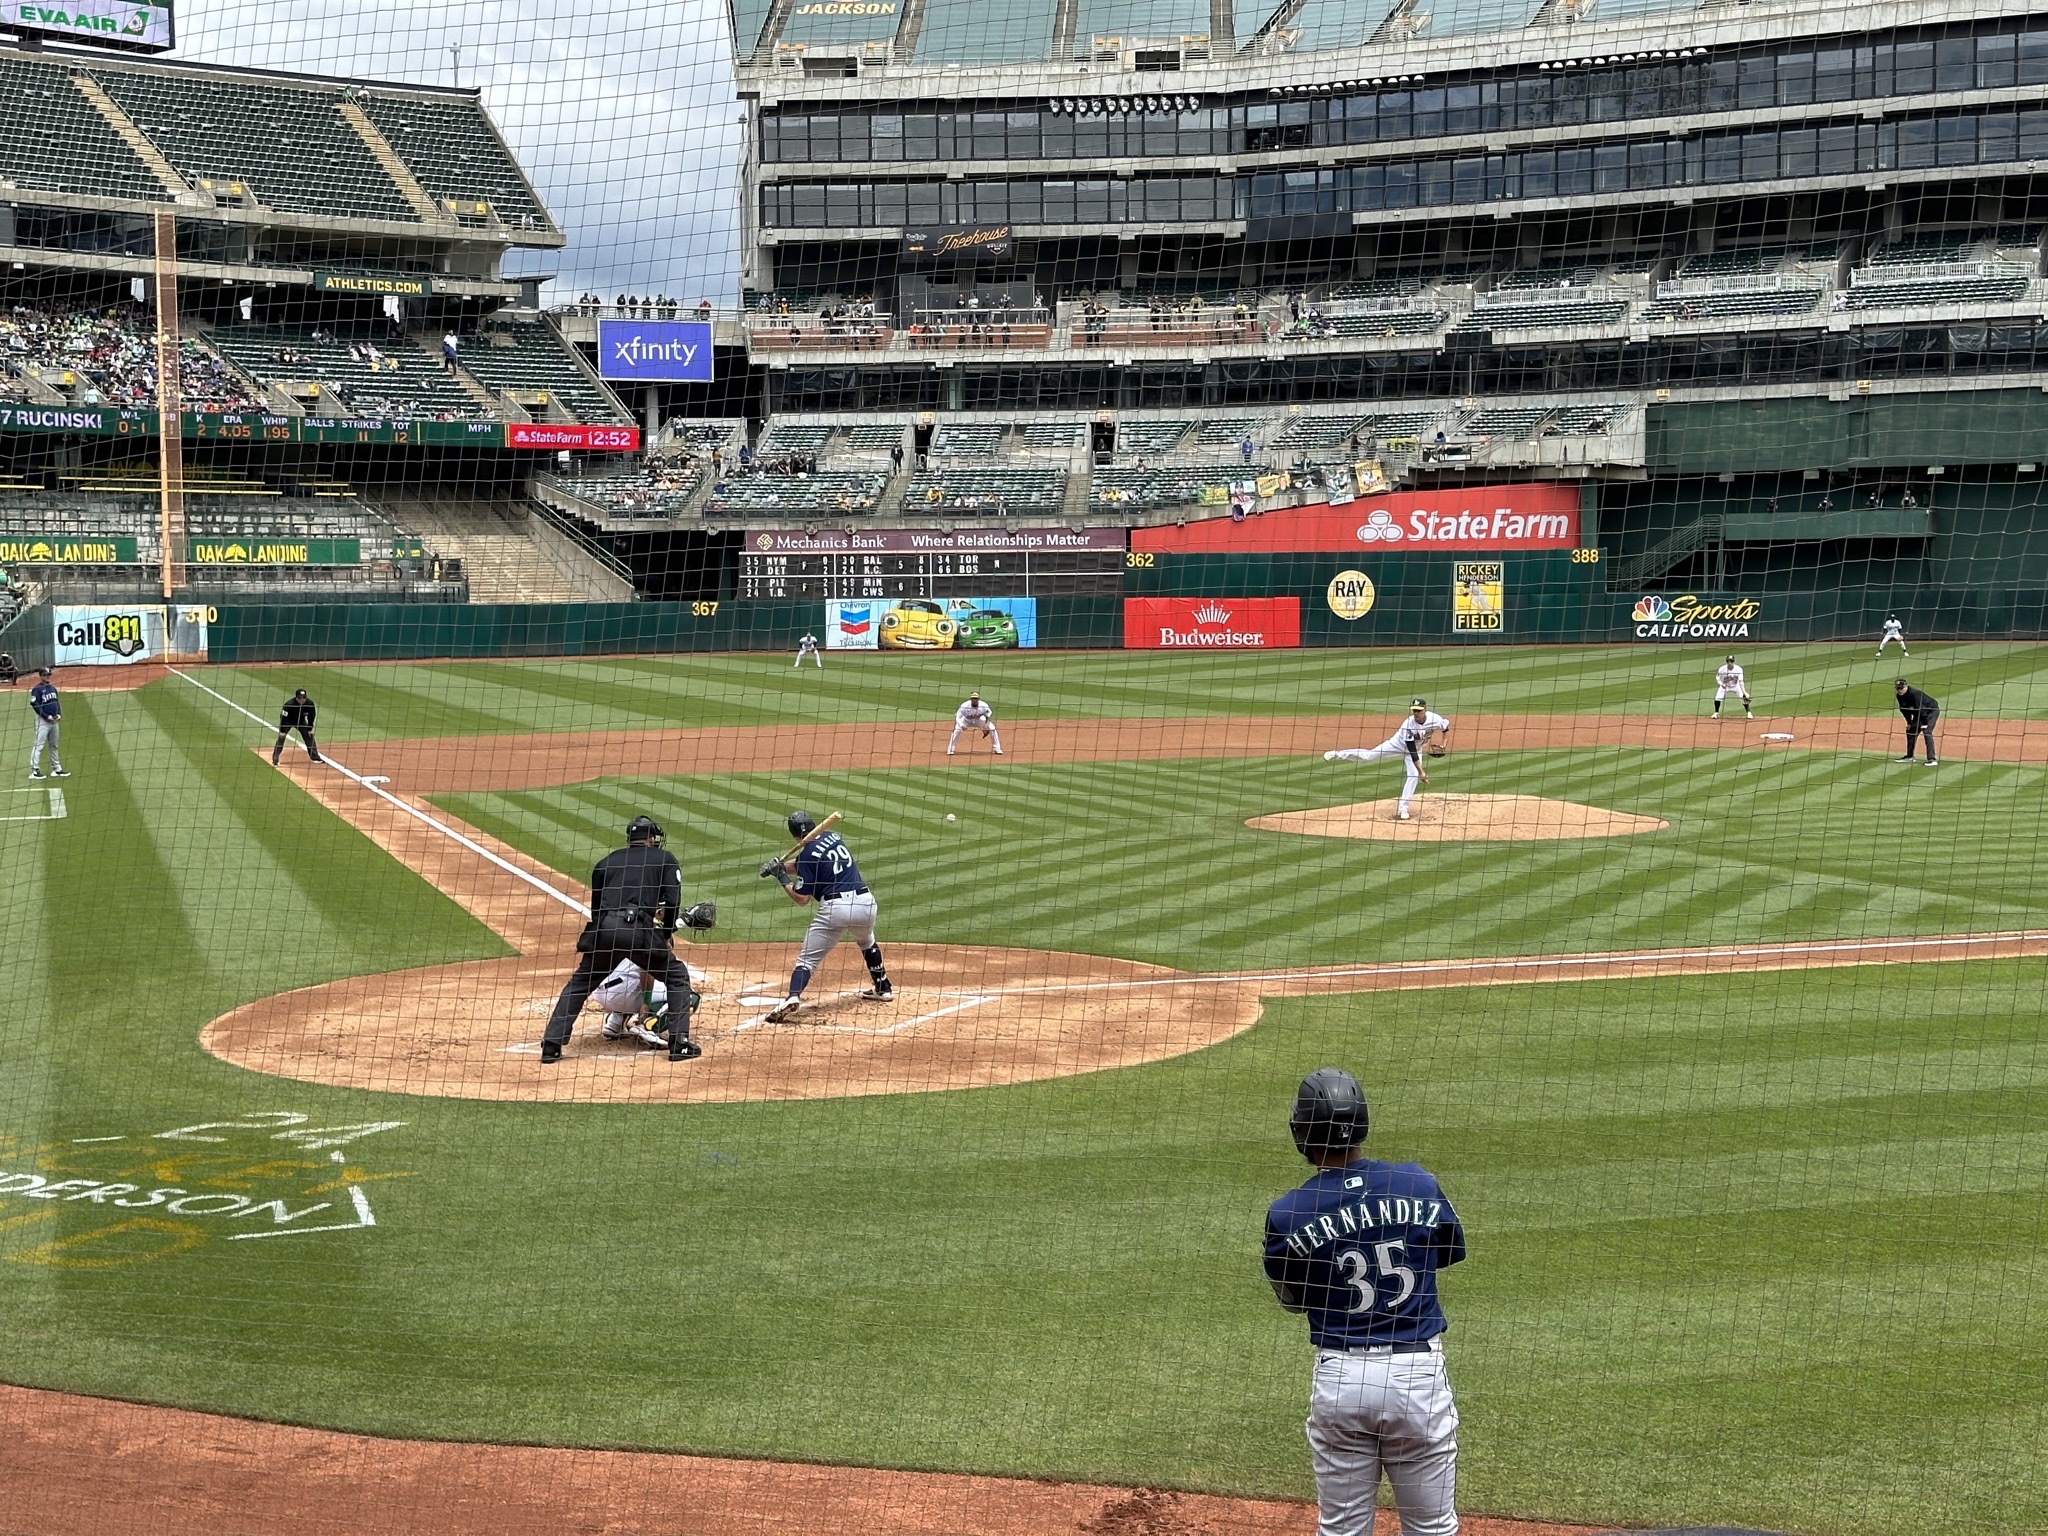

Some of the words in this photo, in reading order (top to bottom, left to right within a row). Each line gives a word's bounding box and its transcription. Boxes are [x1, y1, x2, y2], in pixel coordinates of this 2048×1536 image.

[796, 3, 896, 14] JACKSON
[20, 6, 71, 26] EVA
[74, 14, 118, 32] AIR
[933, 226, 1009, 256] Treehouse
[325, 276, 423, 294] ATHLETICS.COM
[615, 336, 698, 367] xfinity
[16, 410, 103, 429] RUCINSKI
[196, 414, 204, 423] K
[223, 415, 242, 424] ERA
[261, 416, 288, 426] WHIP
[304, 418, 335, 428] BALLS
[341, 419, 382, 429] STRIKES
[391, 421, 410, 431] TOT
[468, 423, 491, 433] MPH
[197, 425, 206, 437] 2
[218, 426, 251, 437] 4.05
[262, 426, 291, 439] 1.95
[319, 429, 323, 441] 1
[395, 431, 408, 444] 12
[588, 430, 631, 446] 12:52
[776, 535, 848, 549] Mechanics
[852, 535, 886, 549] Bank
[911, 533, 957, 548] Where
[958, 532, 1042, 549] Relationships
[1045, 533, 1090, 547] Matter
[0, 543, 31, 561] OAK
[54, 543, 117, 562] LANDING
[196, 544, 224, 562] OAK
[249, 544, 307, 562] LANDING
[863, 556, 882, 565] BAL
[959, 555, 979, 564] TOR
[1126, 553, 1154, 568] 362
[1572, 549, 1600, 564] 388
[766, 556, 787, 566] NYM
[767, 566, 786, 576] DET
[823, 566, 829, 575] 2
[864, 566, 882, 575] K.C.
[959, 565, 979, 574] BOS
[1458, 565, 1499, 576] RICKEY
[769, 578, 786, 587] PIT
[863, 577, 882, 587] MIN
[1335, 580, 1367, 597] RAY
[769, 588, 787, 597] T.B.
[863, 587, 884, 596] CWS
[692, 602, 719, 617] 367
[1670, 595, 1761, 625] Sports
[1457, 614, 1499, 629] FIELD
[57, 622, 101, 647] Call
[105, 615, 141, 641] 811
[1636, 624, 1749, 638] CALIFORNIA
[826, 844, 853, 875] 29
[0, 1171, 333, 1224] DERSON
[1286, 1190, 1443, 1258] HERNÁNDEZ
[1335, 1239, 1417, 1315] 35
